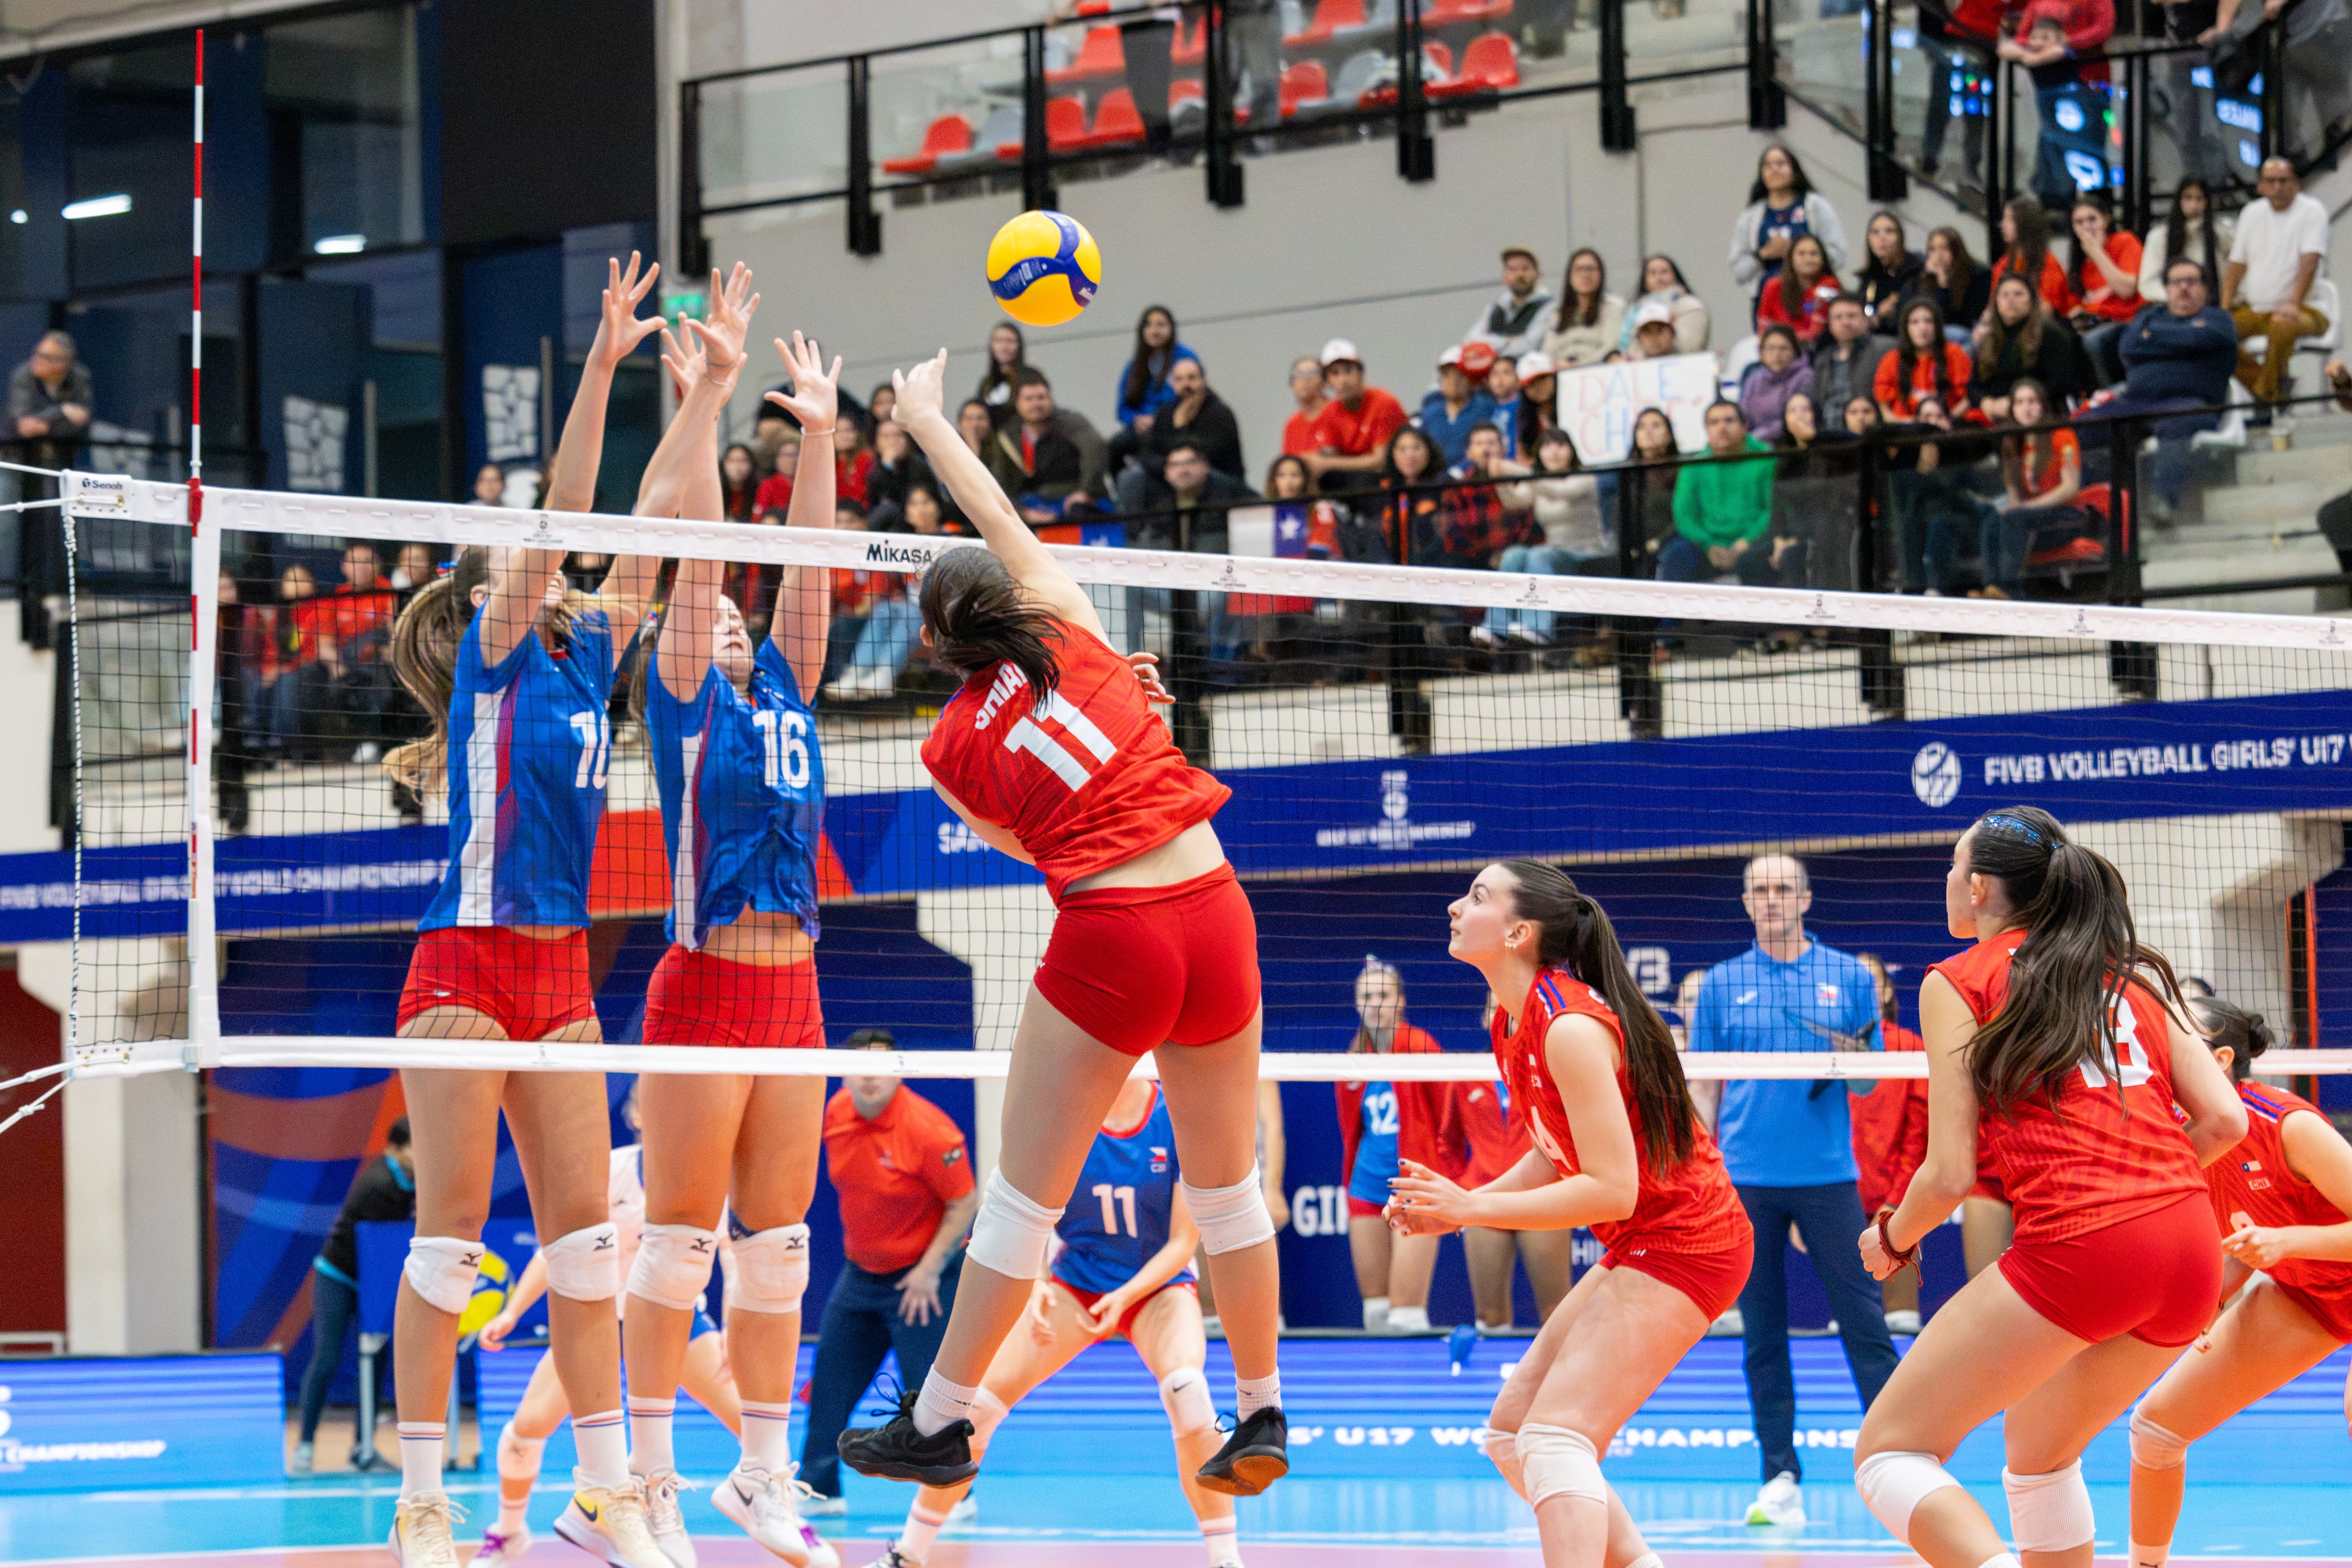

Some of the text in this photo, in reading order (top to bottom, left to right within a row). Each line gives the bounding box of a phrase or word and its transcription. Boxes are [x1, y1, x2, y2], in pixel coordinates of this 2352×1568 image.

[751, 709, 810, 789] 16
[1003, 688, 1118, 793] 11
[1985, 755, 2044, 786] FIVB
[2048, 743, 2209, 781] VOLLEYBALL
[2300, 734, 2345, 765] U17
[1365, 1090, 1402, 1136] 12
[1092, 1184, 1138, 1239] 11
[1292, 1184, 1349, 1238] GI
[1335, 1426, 1414, 1446] U17
